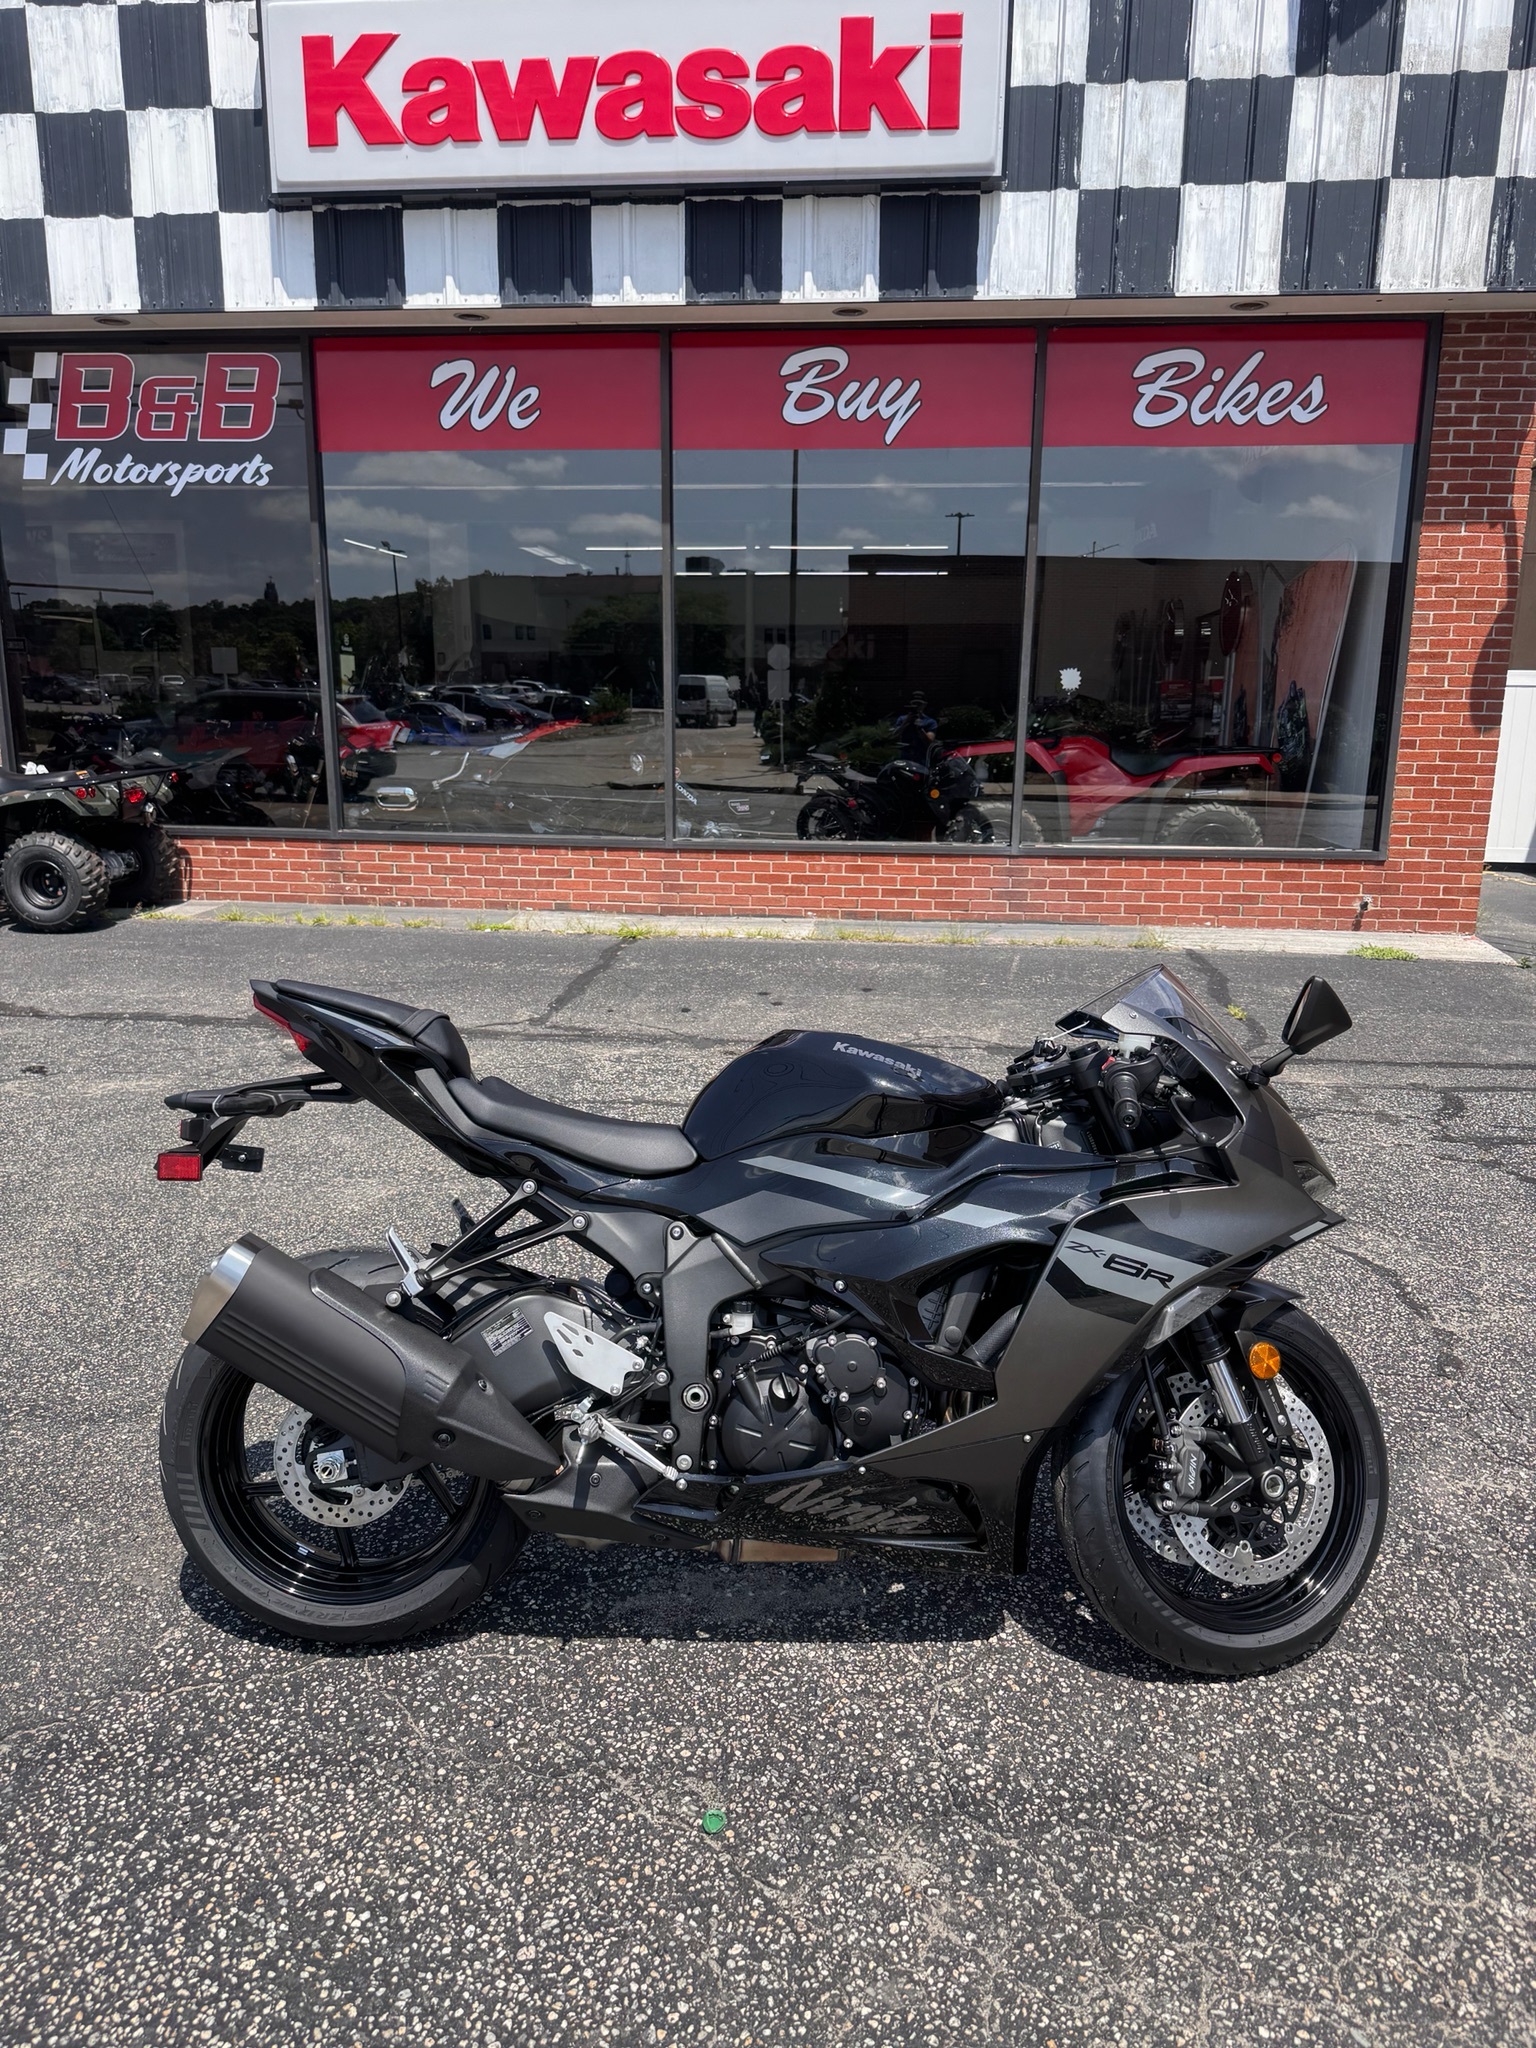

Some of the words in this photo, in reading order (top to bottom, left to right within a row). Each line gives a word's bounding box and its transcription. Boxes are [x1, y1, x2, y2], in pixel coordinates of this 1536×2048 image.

[301, 12, 964, 148] Kawasaki
[55, 352, 281, 442] B&B
[430, 358, 541, 431] We
[779, 346, 922, 445] Buy
[1132, 346, 1329, 429] Bikes
[51, 447, 273, 497] Motorsports
[832, 1041, 922, 1077] Kawasaki
[764, 1478, 933, 1535] Ninja
